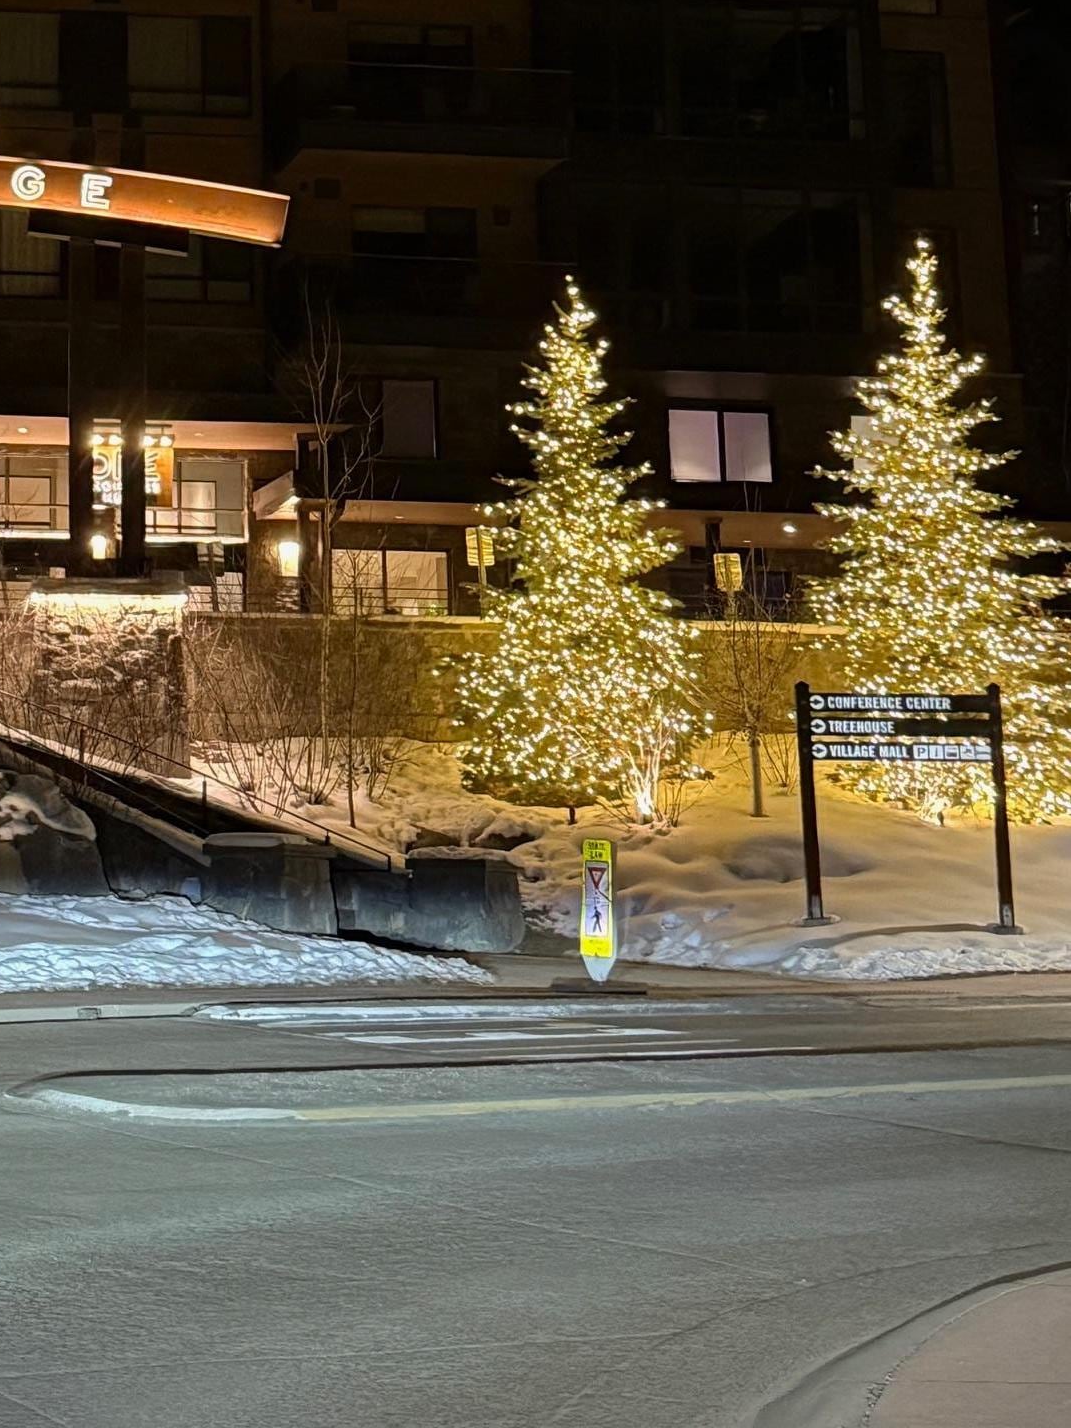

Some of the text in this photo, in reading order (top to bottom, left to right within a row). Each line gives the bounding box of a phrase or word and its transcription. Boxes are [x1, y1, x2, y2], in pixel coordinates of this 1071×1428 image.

[827, 696, 951, 710] CONFERENCE CENTER
[828, 720, 896, 734] TREEHOUSE
[830, 744, 875, 758] VILLAGE
[879, 745, 910, 759] MALL
